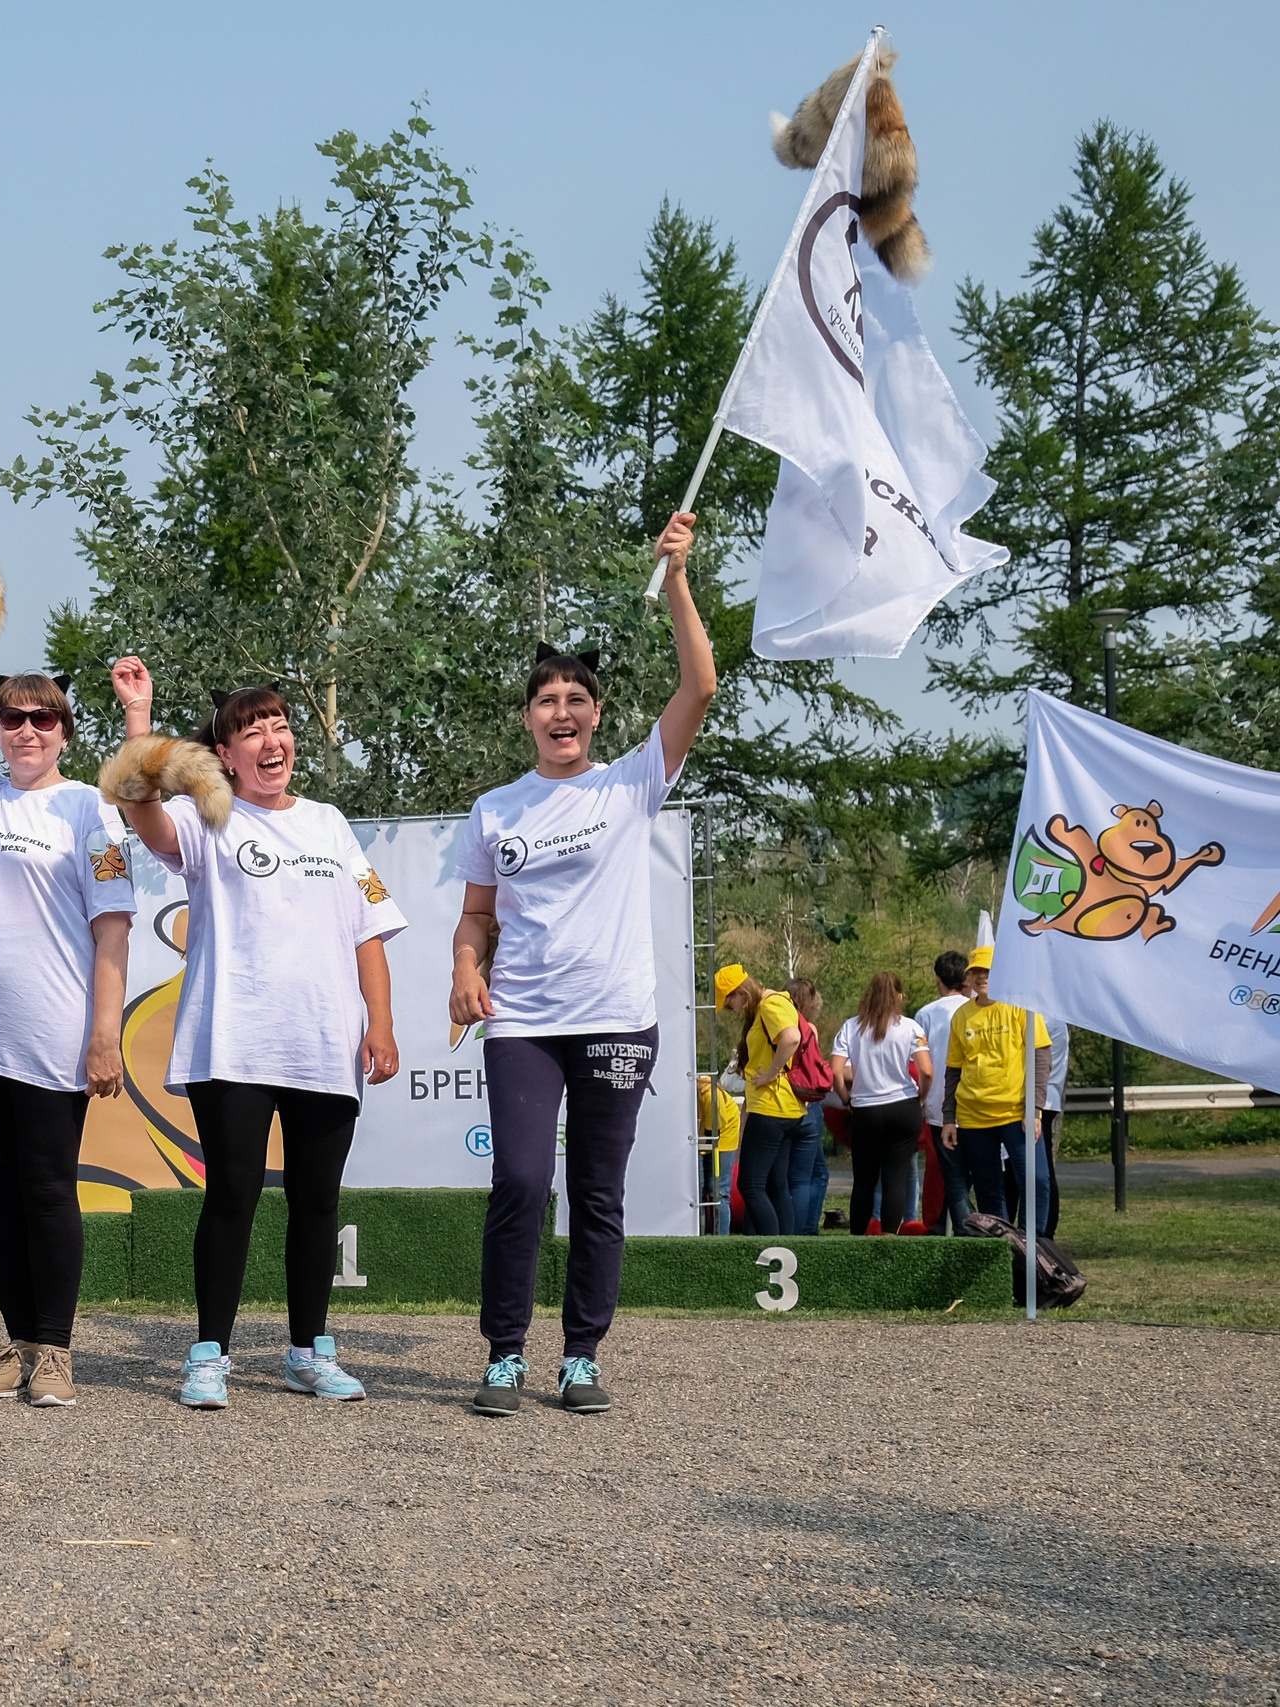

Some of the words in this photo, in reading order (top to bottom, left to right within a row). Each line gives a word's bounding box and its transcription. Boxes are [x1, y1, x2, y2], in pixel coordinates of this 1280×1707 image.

[534, 821, 608, 850] Сибирские
[0, 844, 27, 853] меха
[557, 842, 591, 857] меха
[304, 869, 335, 879] меха
[586, 1043, 653, 1060] UNIVERSITY
[611, 1057, 637, 1073] 82
[593, 1069, 646, 1081] BASKETBALL
[611, 1080, 635, 1090] TEAM
[332, 1224, 367, 1287] 1
[755, 1246, 800, 1312] 3
